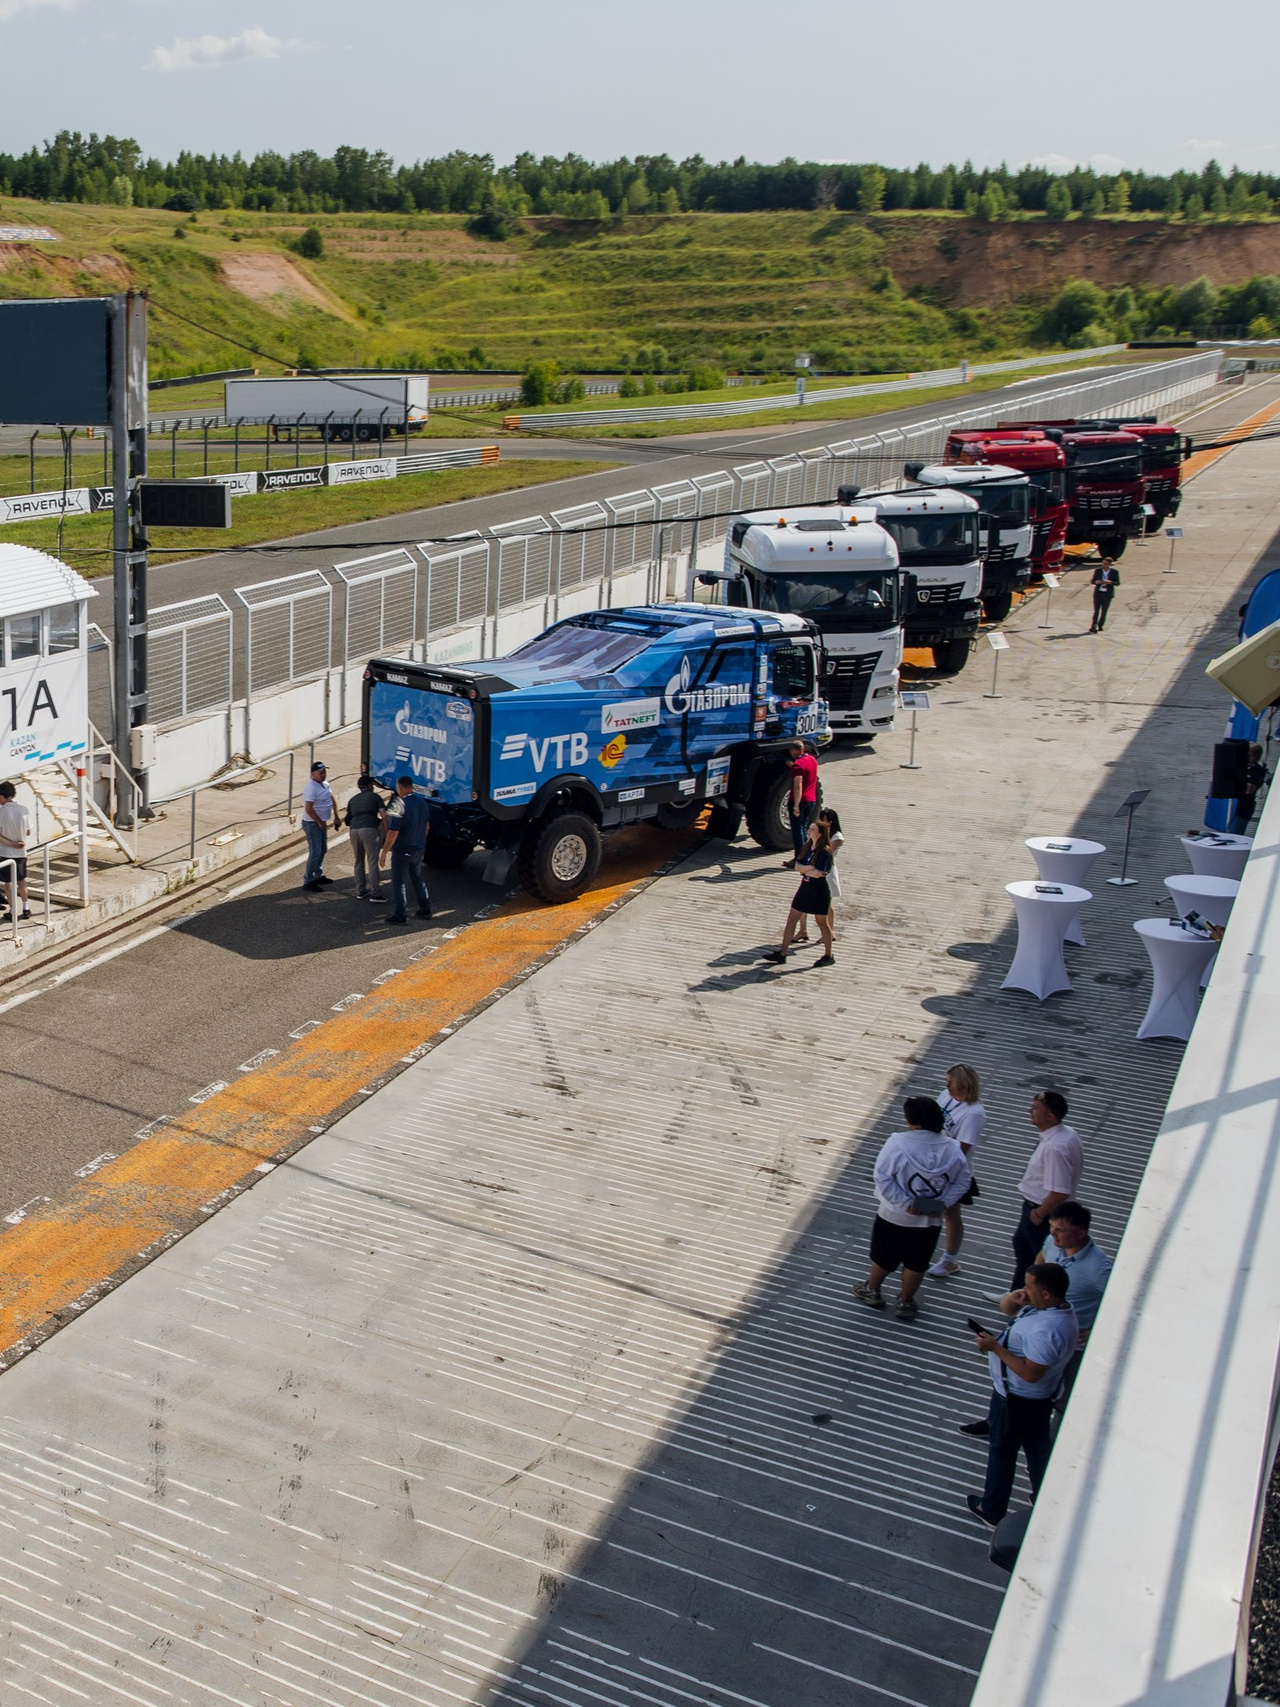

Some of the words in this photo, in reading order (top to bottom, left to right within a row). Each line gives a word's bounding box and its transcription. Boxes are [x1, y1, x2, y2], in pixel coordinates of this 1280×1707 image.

[269, 472, 318, 486] RAVENOL
[340, 464, 385, 477] RAVENOL
[13, 497, 75, 514] RAVENOL
[1, 679, 59, 731] 1A
[614, 714, 657, 728] TATNEFT
[797, 714, 816, 735] 300
[529, 732, 589, 773] VTB
[410, 753, 447, 783] VTB
